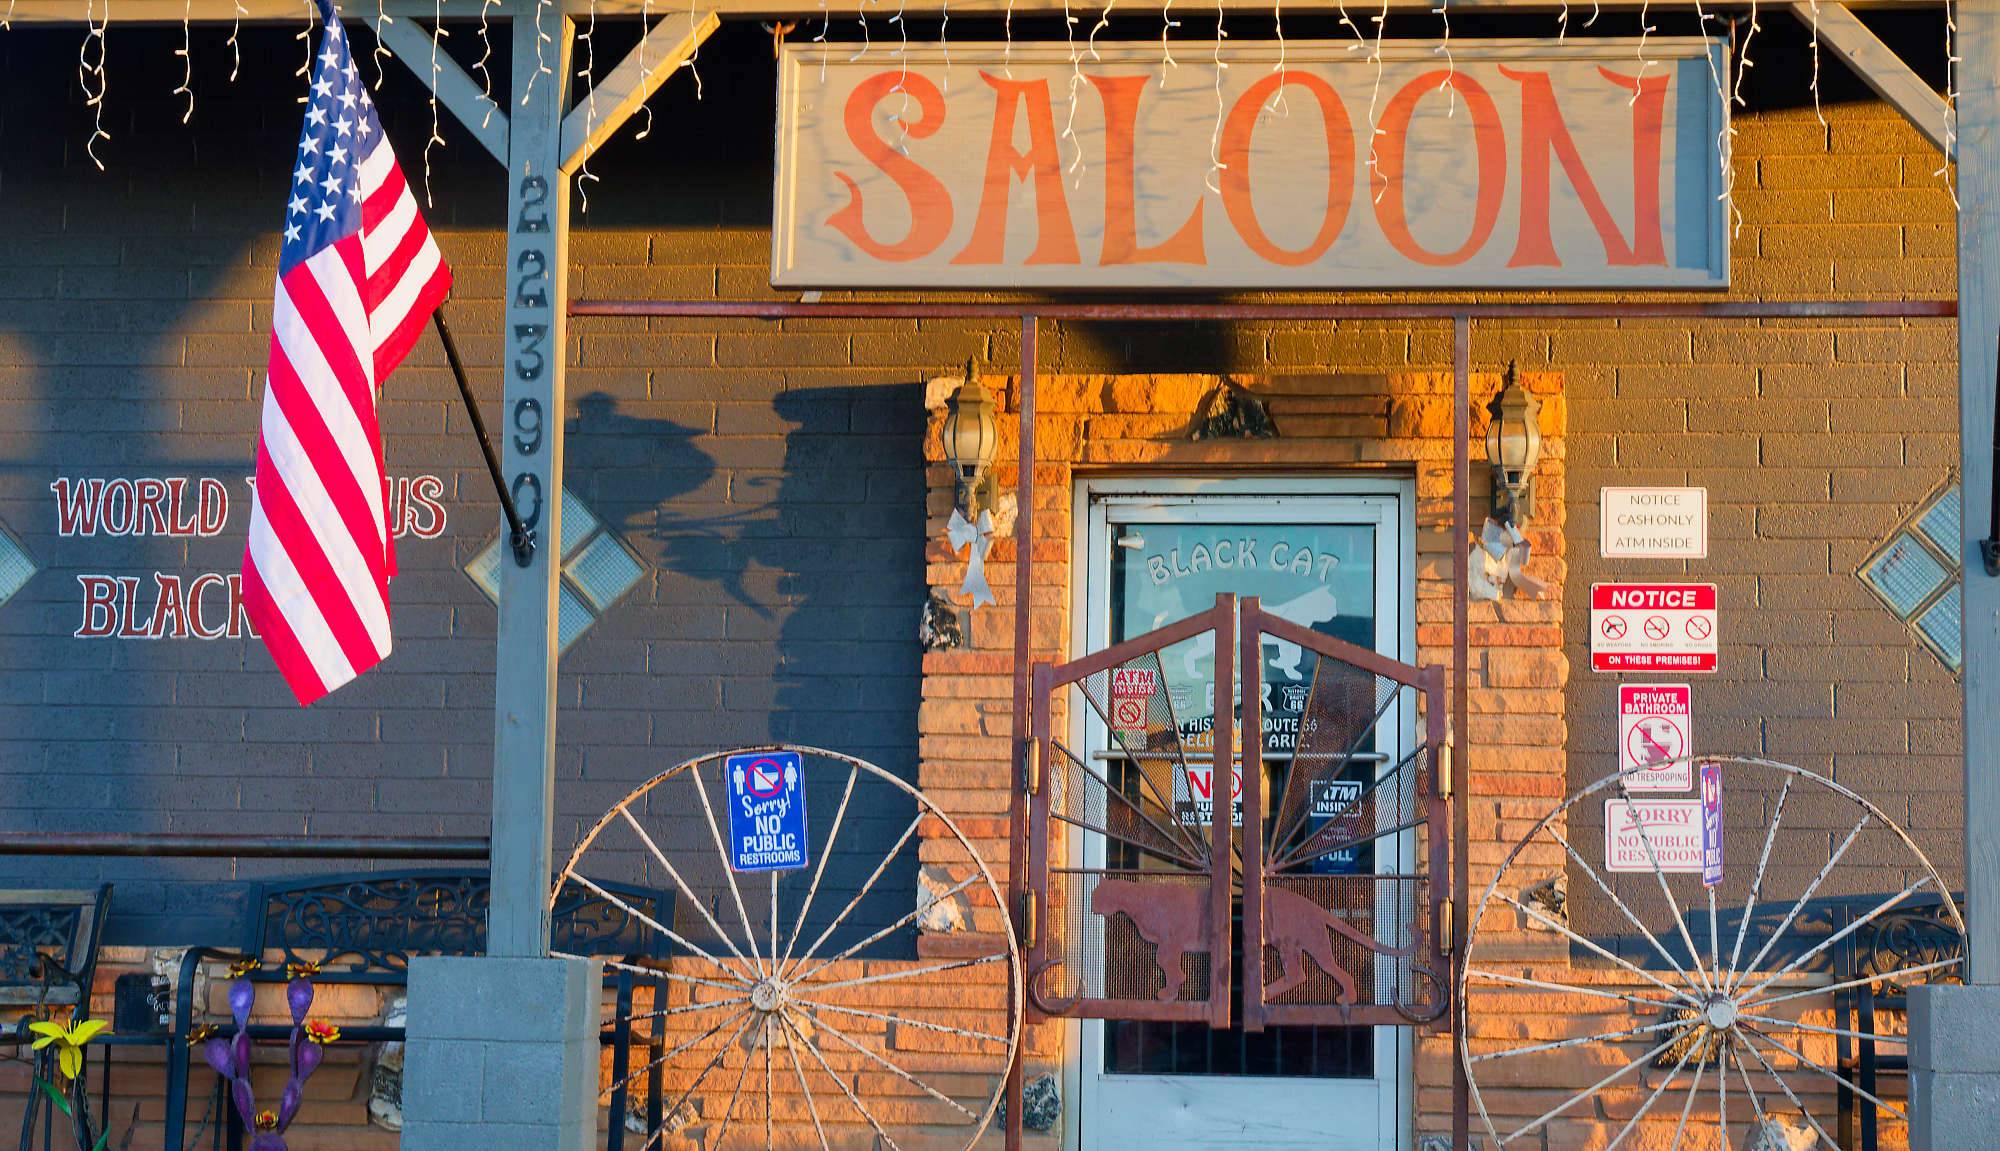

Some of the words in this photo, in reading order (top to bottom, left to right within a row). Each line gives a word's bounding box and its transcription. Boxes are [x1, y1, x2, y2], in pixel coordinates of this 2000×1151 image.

[824, 69, 1672, 268] SALOON
[1630, 494, 1681, 506] NOTICE
[51, 478, 228, 537] WORLD
[1617, 514, 1653, 526] CASH
[1657, 514, 1694, 526] ONLY
[1616, 538, 1645, 549] ATM
[1648, 538, 1693, 549] INSIDE
[1147, 538, 1259, 586] BLACK
[1269, 540, 1341, 584] CAT
[1611, 590, 1697, 607] NOTICE
[1609, 656, 1621, 664] ON
[1625, 656, 1652, 665] THESE
[1656, 656, 1701, 665] PREMISES!
[1114, 670, 1155, 684] ATM
[1633, 693, 1678, 703] PRIVATE
[1625, 703, 1686, 714] BATHROOM
[1263, 718, 1299, 732] OUTE
[1637, 771, 1688, 782] TRESPOOPING
[742, 788, 791, 818] Sorry!
[1625, 809, 1693, 825] SORRY
[756, 814, 781, 836] NO
[743, 833, 796, 853] PUBLIC
[1618, 836, 1639, 849] NO
[740, 850, 801, 866] RESTROOMS
